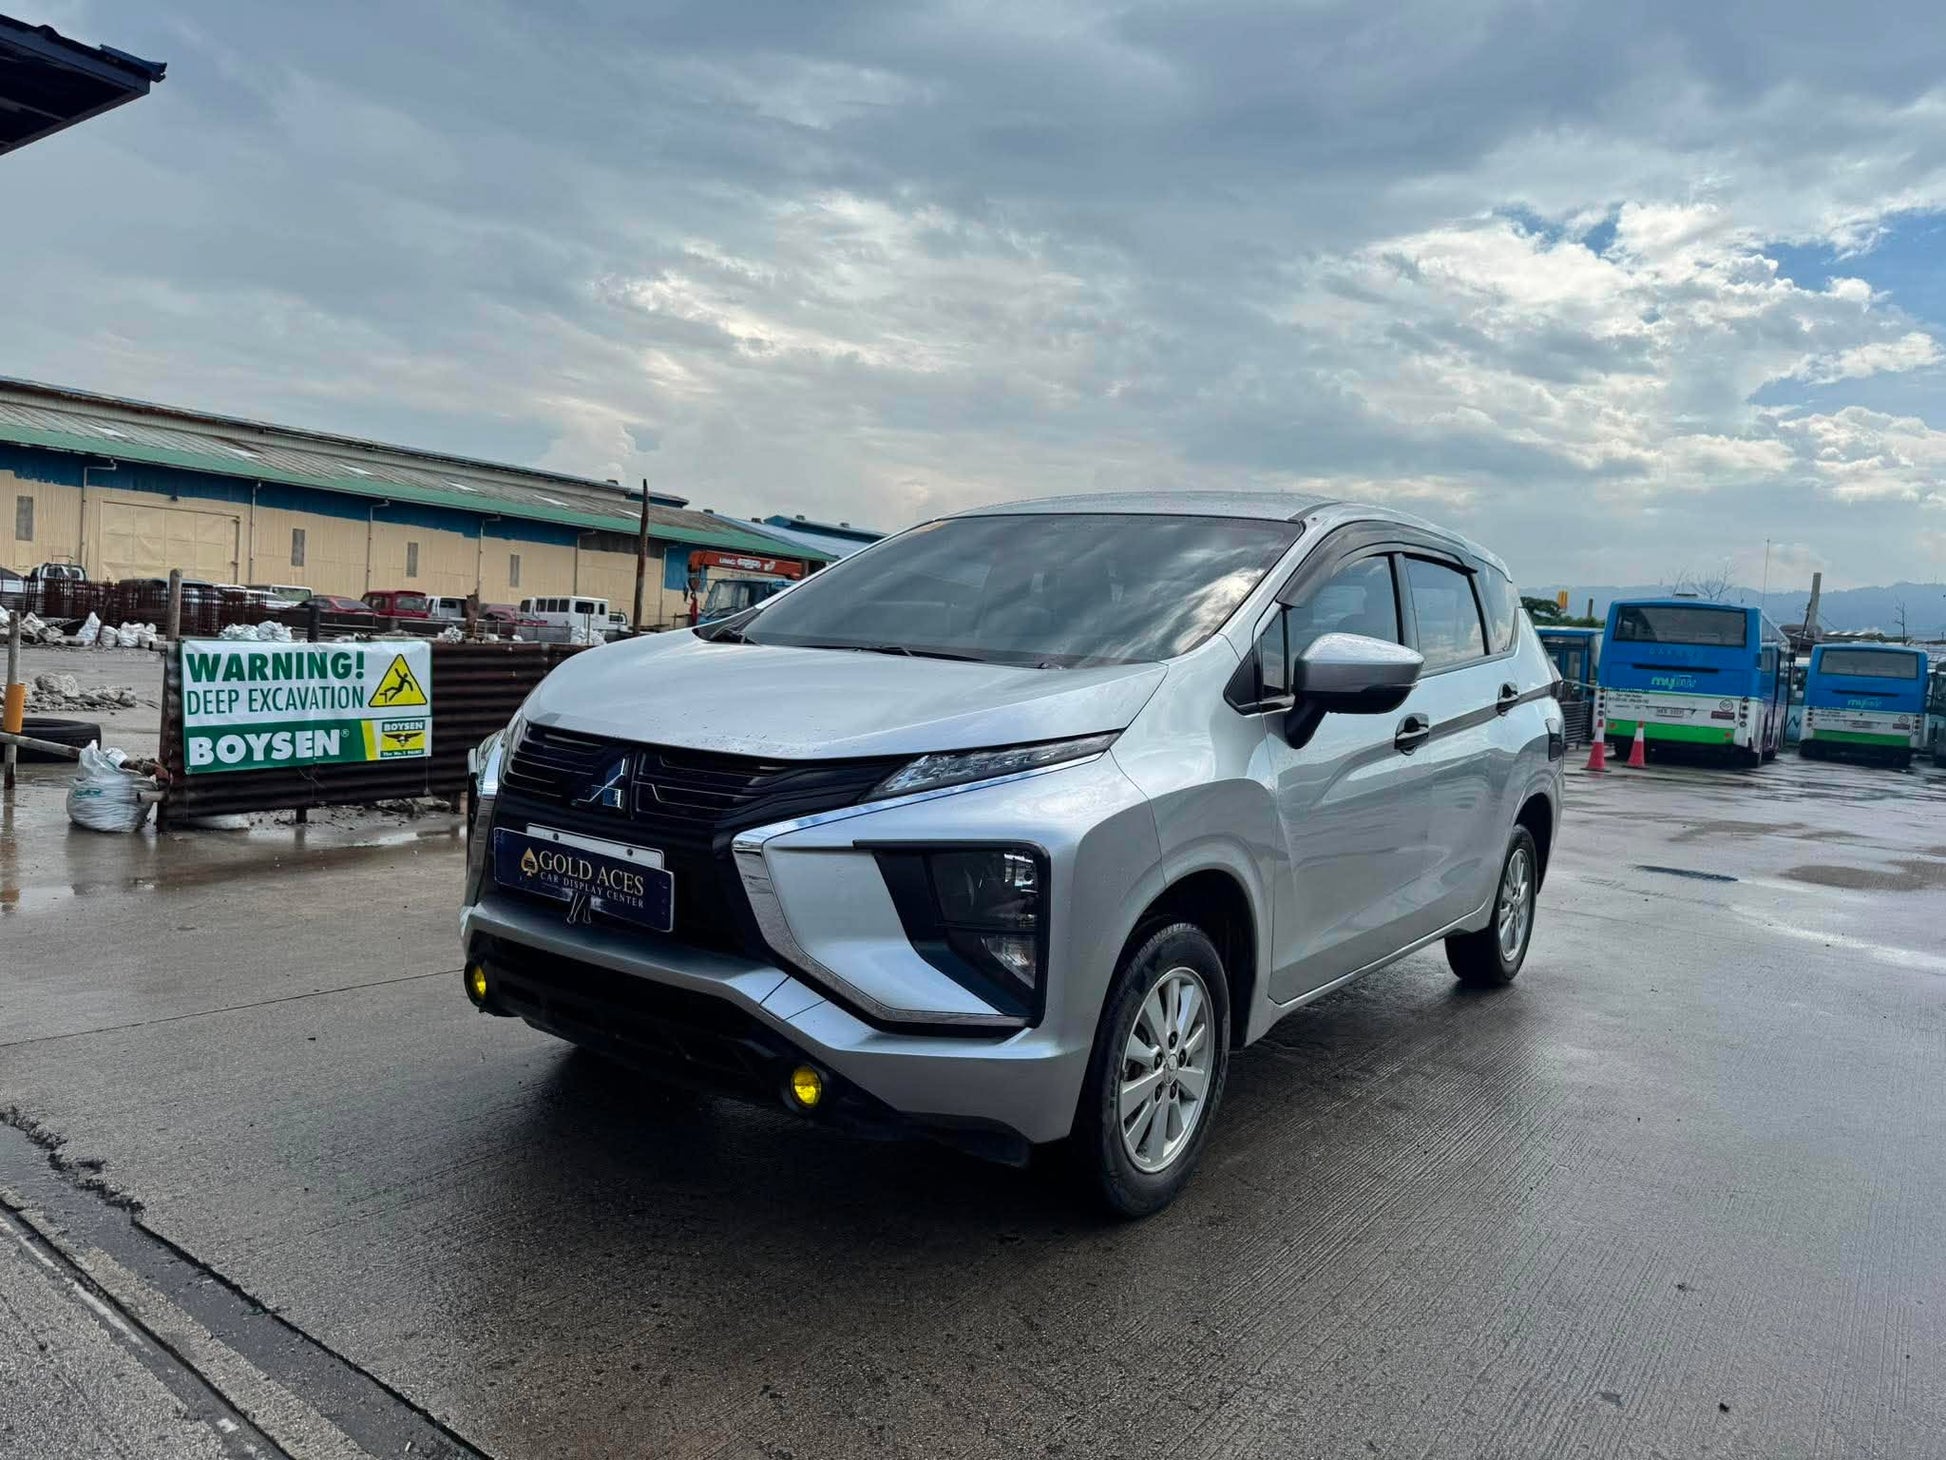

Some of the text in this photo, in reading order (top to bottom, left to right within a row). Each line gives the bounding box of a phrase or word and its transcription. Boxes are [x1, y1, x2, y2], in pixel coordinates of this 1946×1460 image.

[186, 651, 365, 683] WARNING!
[187, 685, 364, 716] DEEP EXCAVATION
[384, 722, 423, 731] BOYSEN
[539, 850, 645, 897] GOLD ACES
[540, 871, 644, 908] CAR DISPLAY CENTER
